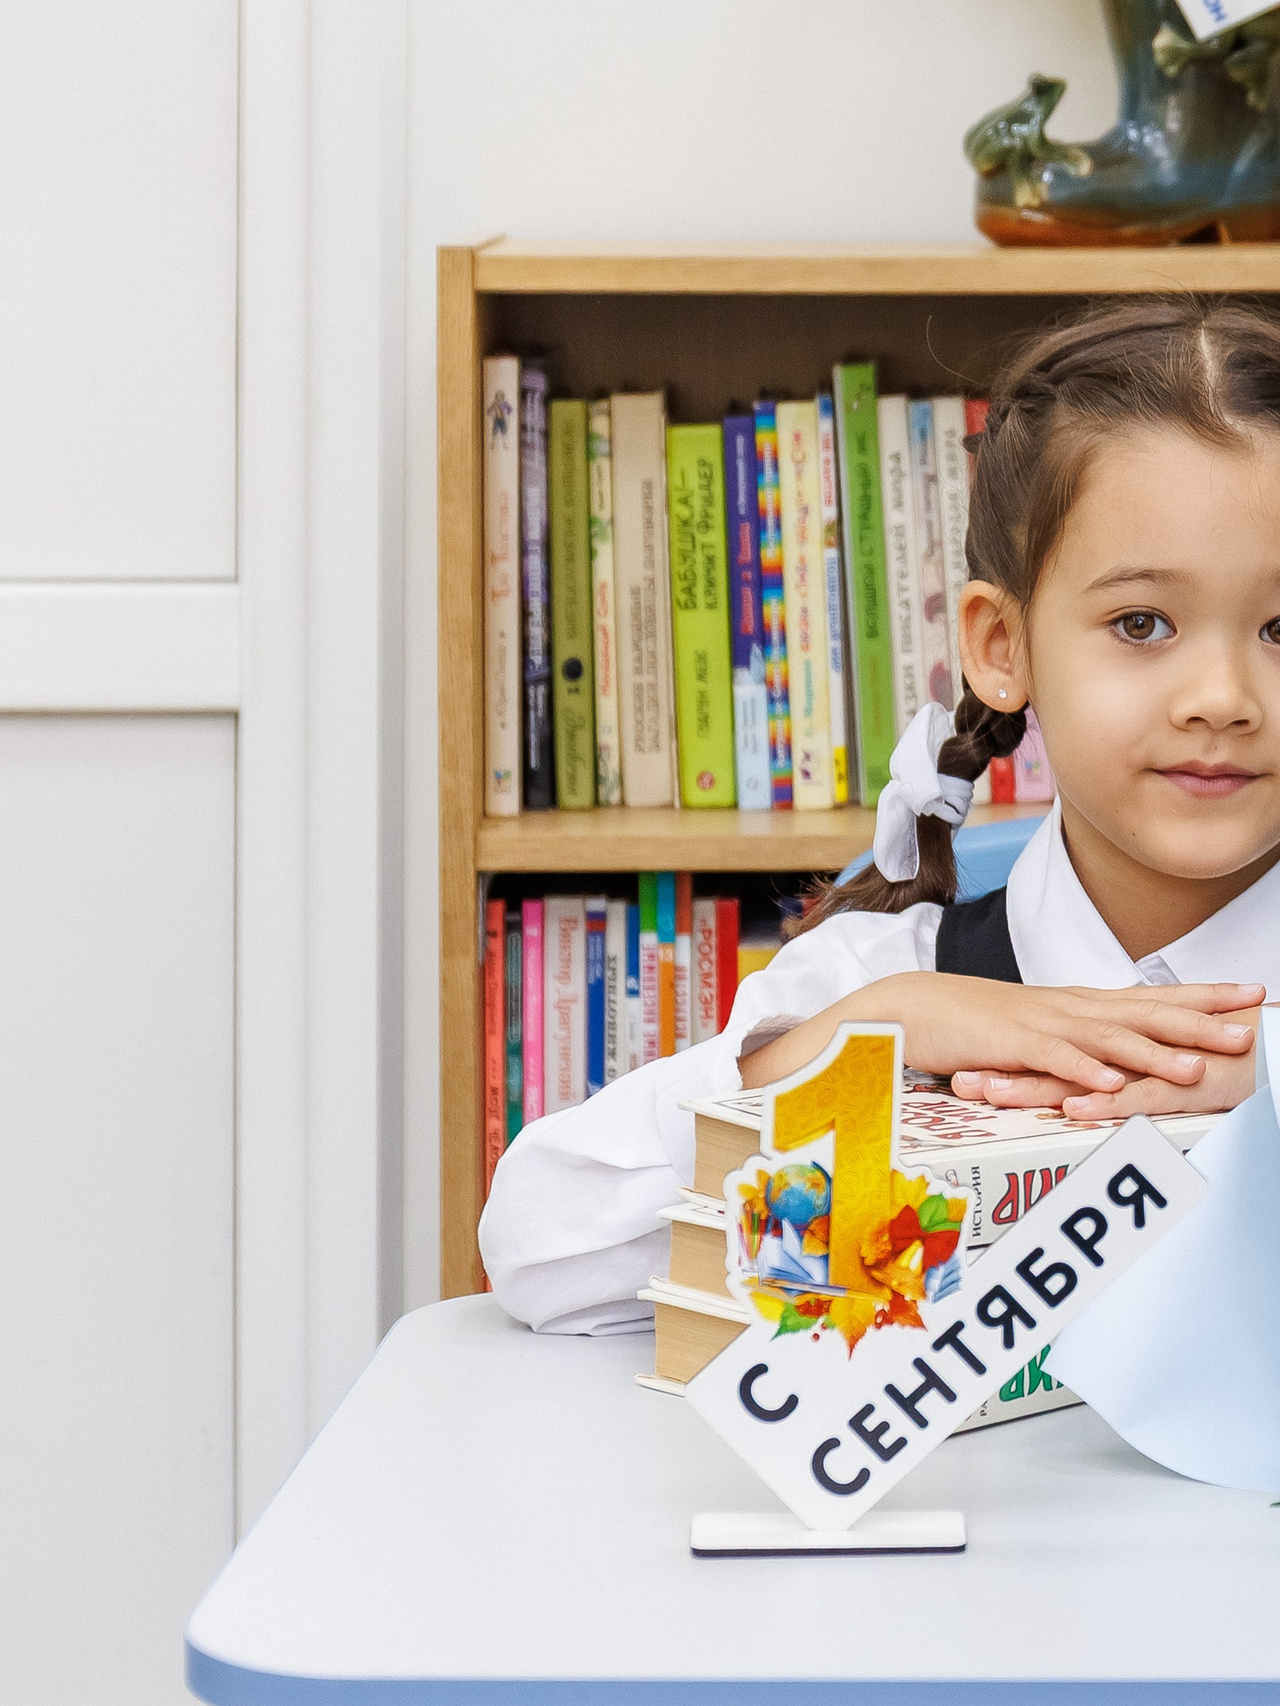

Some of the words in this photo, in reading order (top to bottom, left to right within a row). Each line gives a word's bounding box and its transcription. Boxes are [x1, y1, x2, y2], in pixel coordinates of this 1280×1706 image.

[889, 525, 914, 654] ПИСАТЕЛЕЙ
[971, 1164, 982, 1239] ИСТОРИЯ
[810, 1163, 1169, 1498] СЕНТЯБРЯ
[738, 1362, 800, 1423] С
